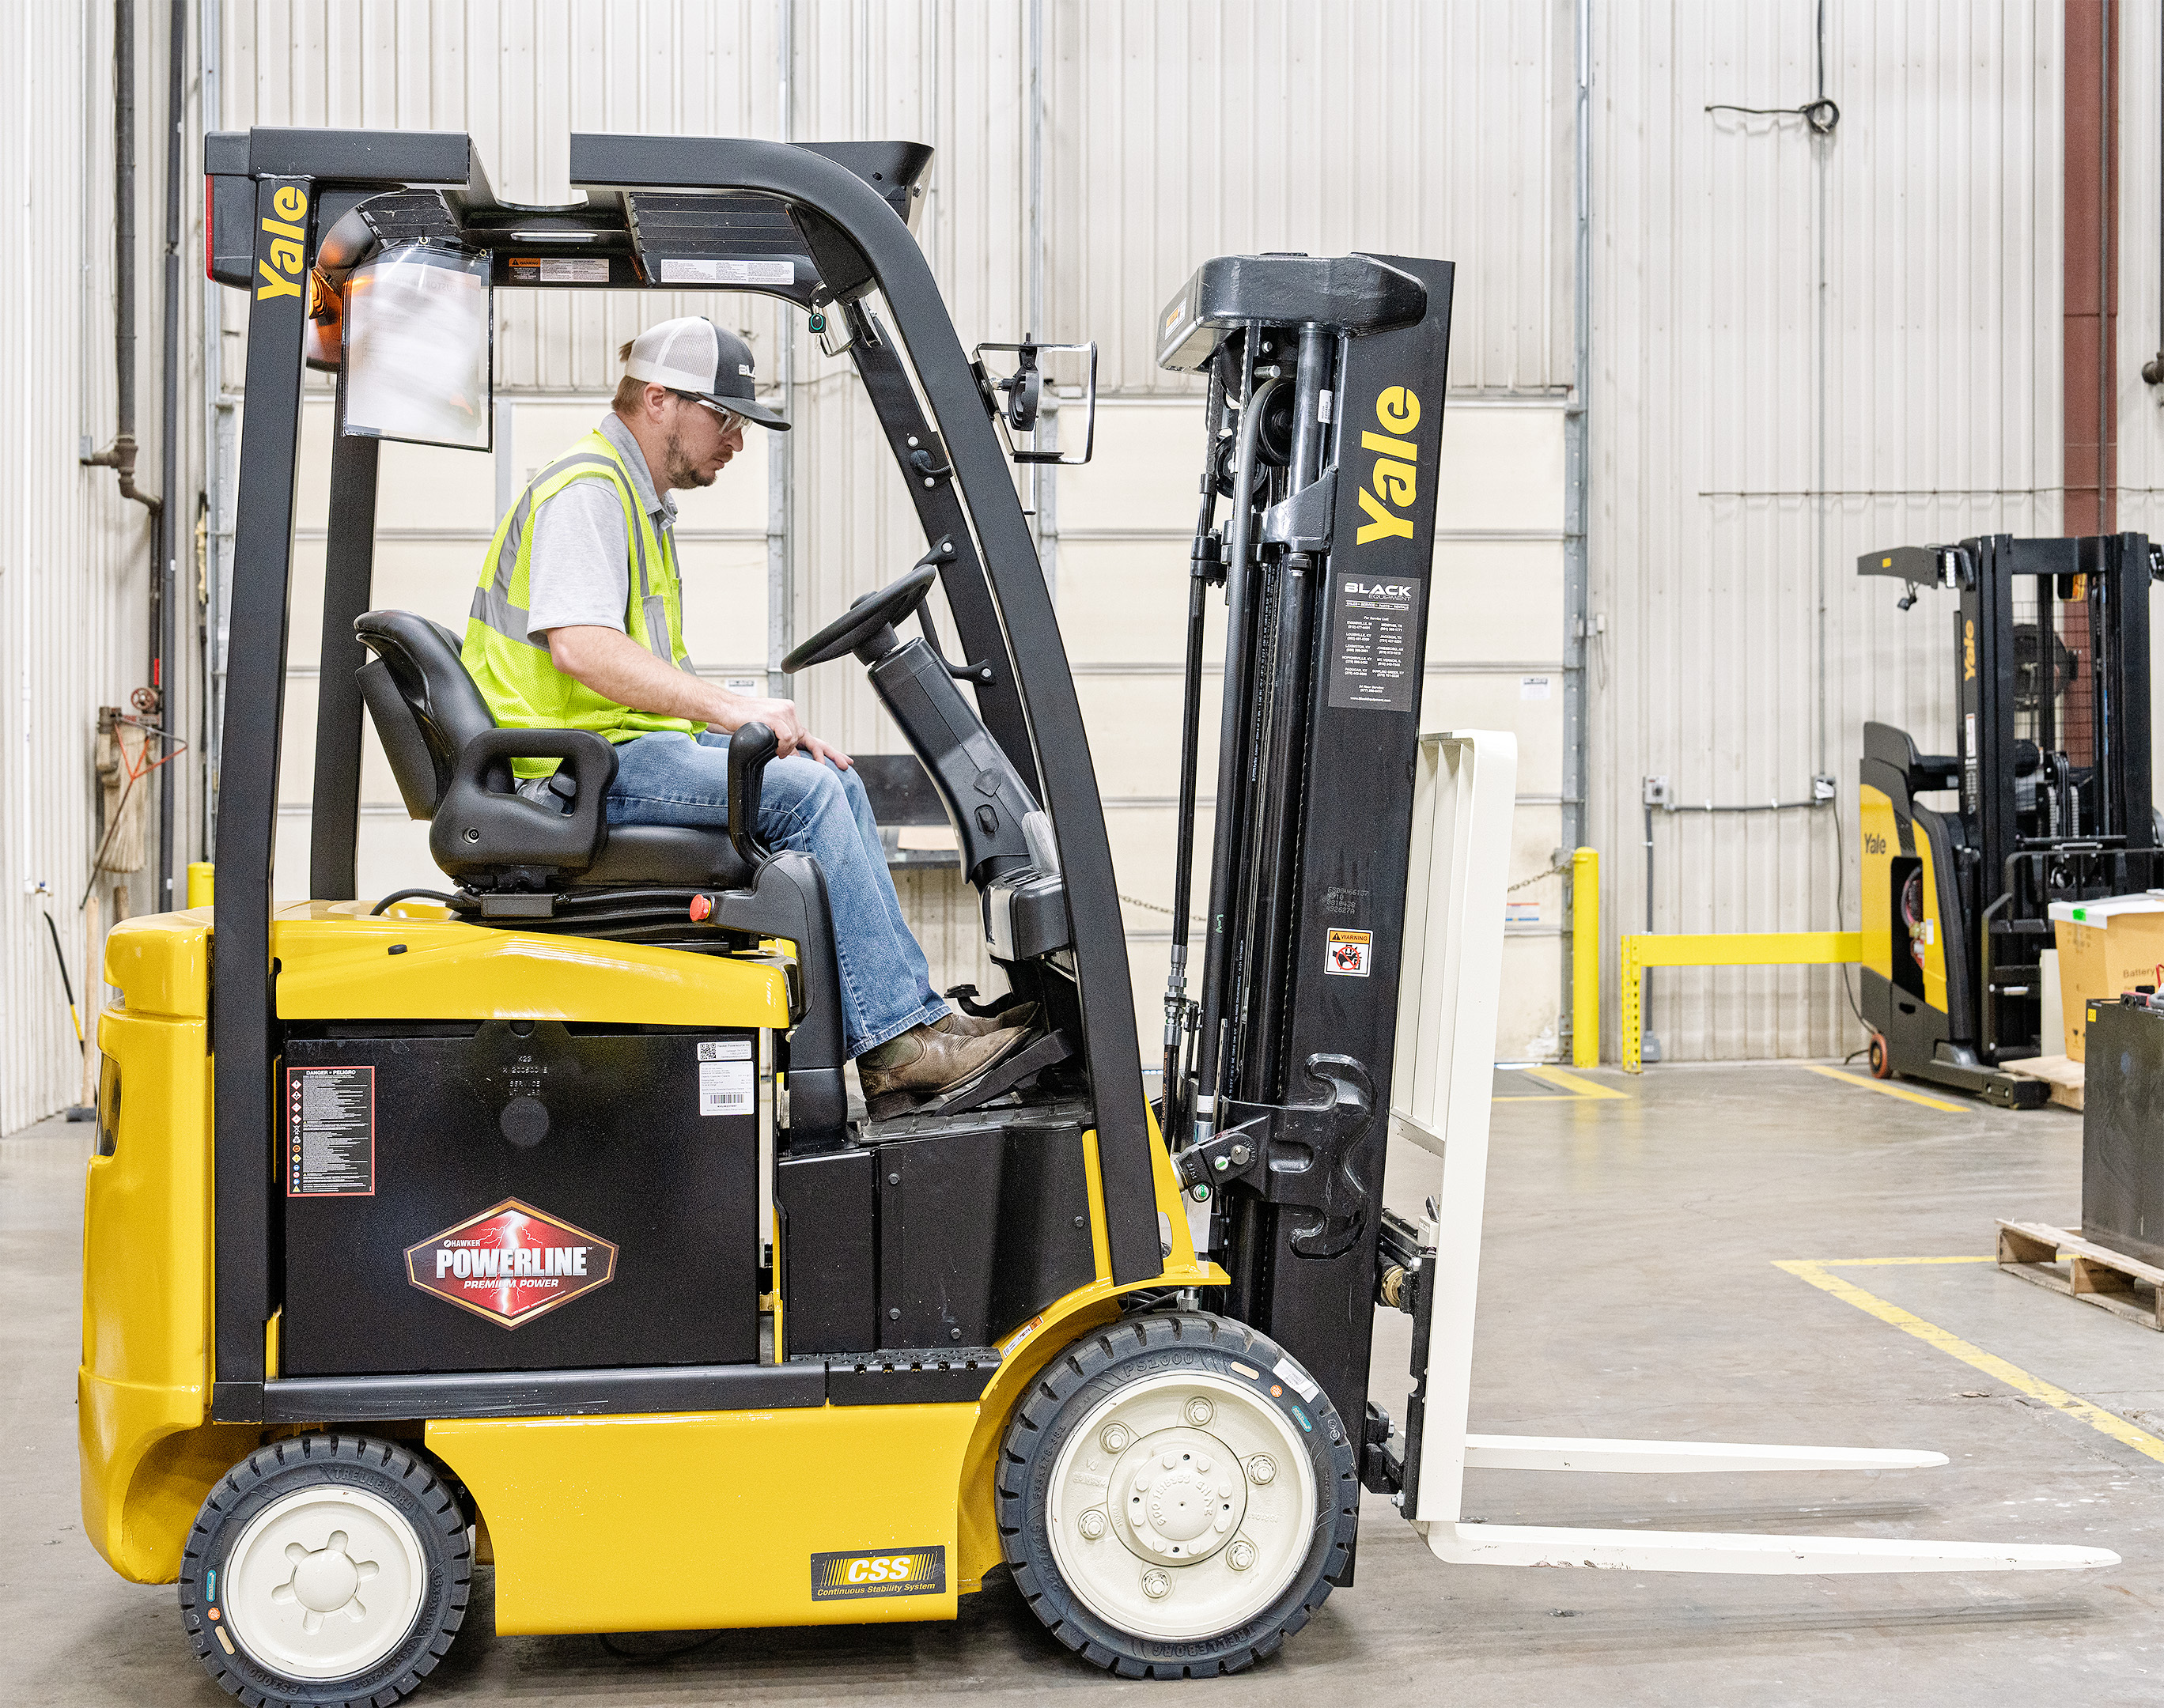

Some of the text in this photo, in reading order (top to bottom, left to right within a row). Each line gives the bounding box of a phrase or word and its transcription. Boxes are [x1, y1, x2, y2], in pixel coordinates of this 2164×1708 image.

[257, 186, 308, 300] Yale
[1356, 385, 1421, 546] Yale
[1345, 582, 1412, 597] BLACK
[1864, 833, 1886, 855] Yale
[2123, 967, 2155, 979] Battery
[463, 1279, 559, 1289] PREMIUM POWER
[1122, 1351, 1194, 1377] PS1000
[848, 1557, 911, 1582] CSS
[817, 1582, 936, 1597] Continuous Stability System
